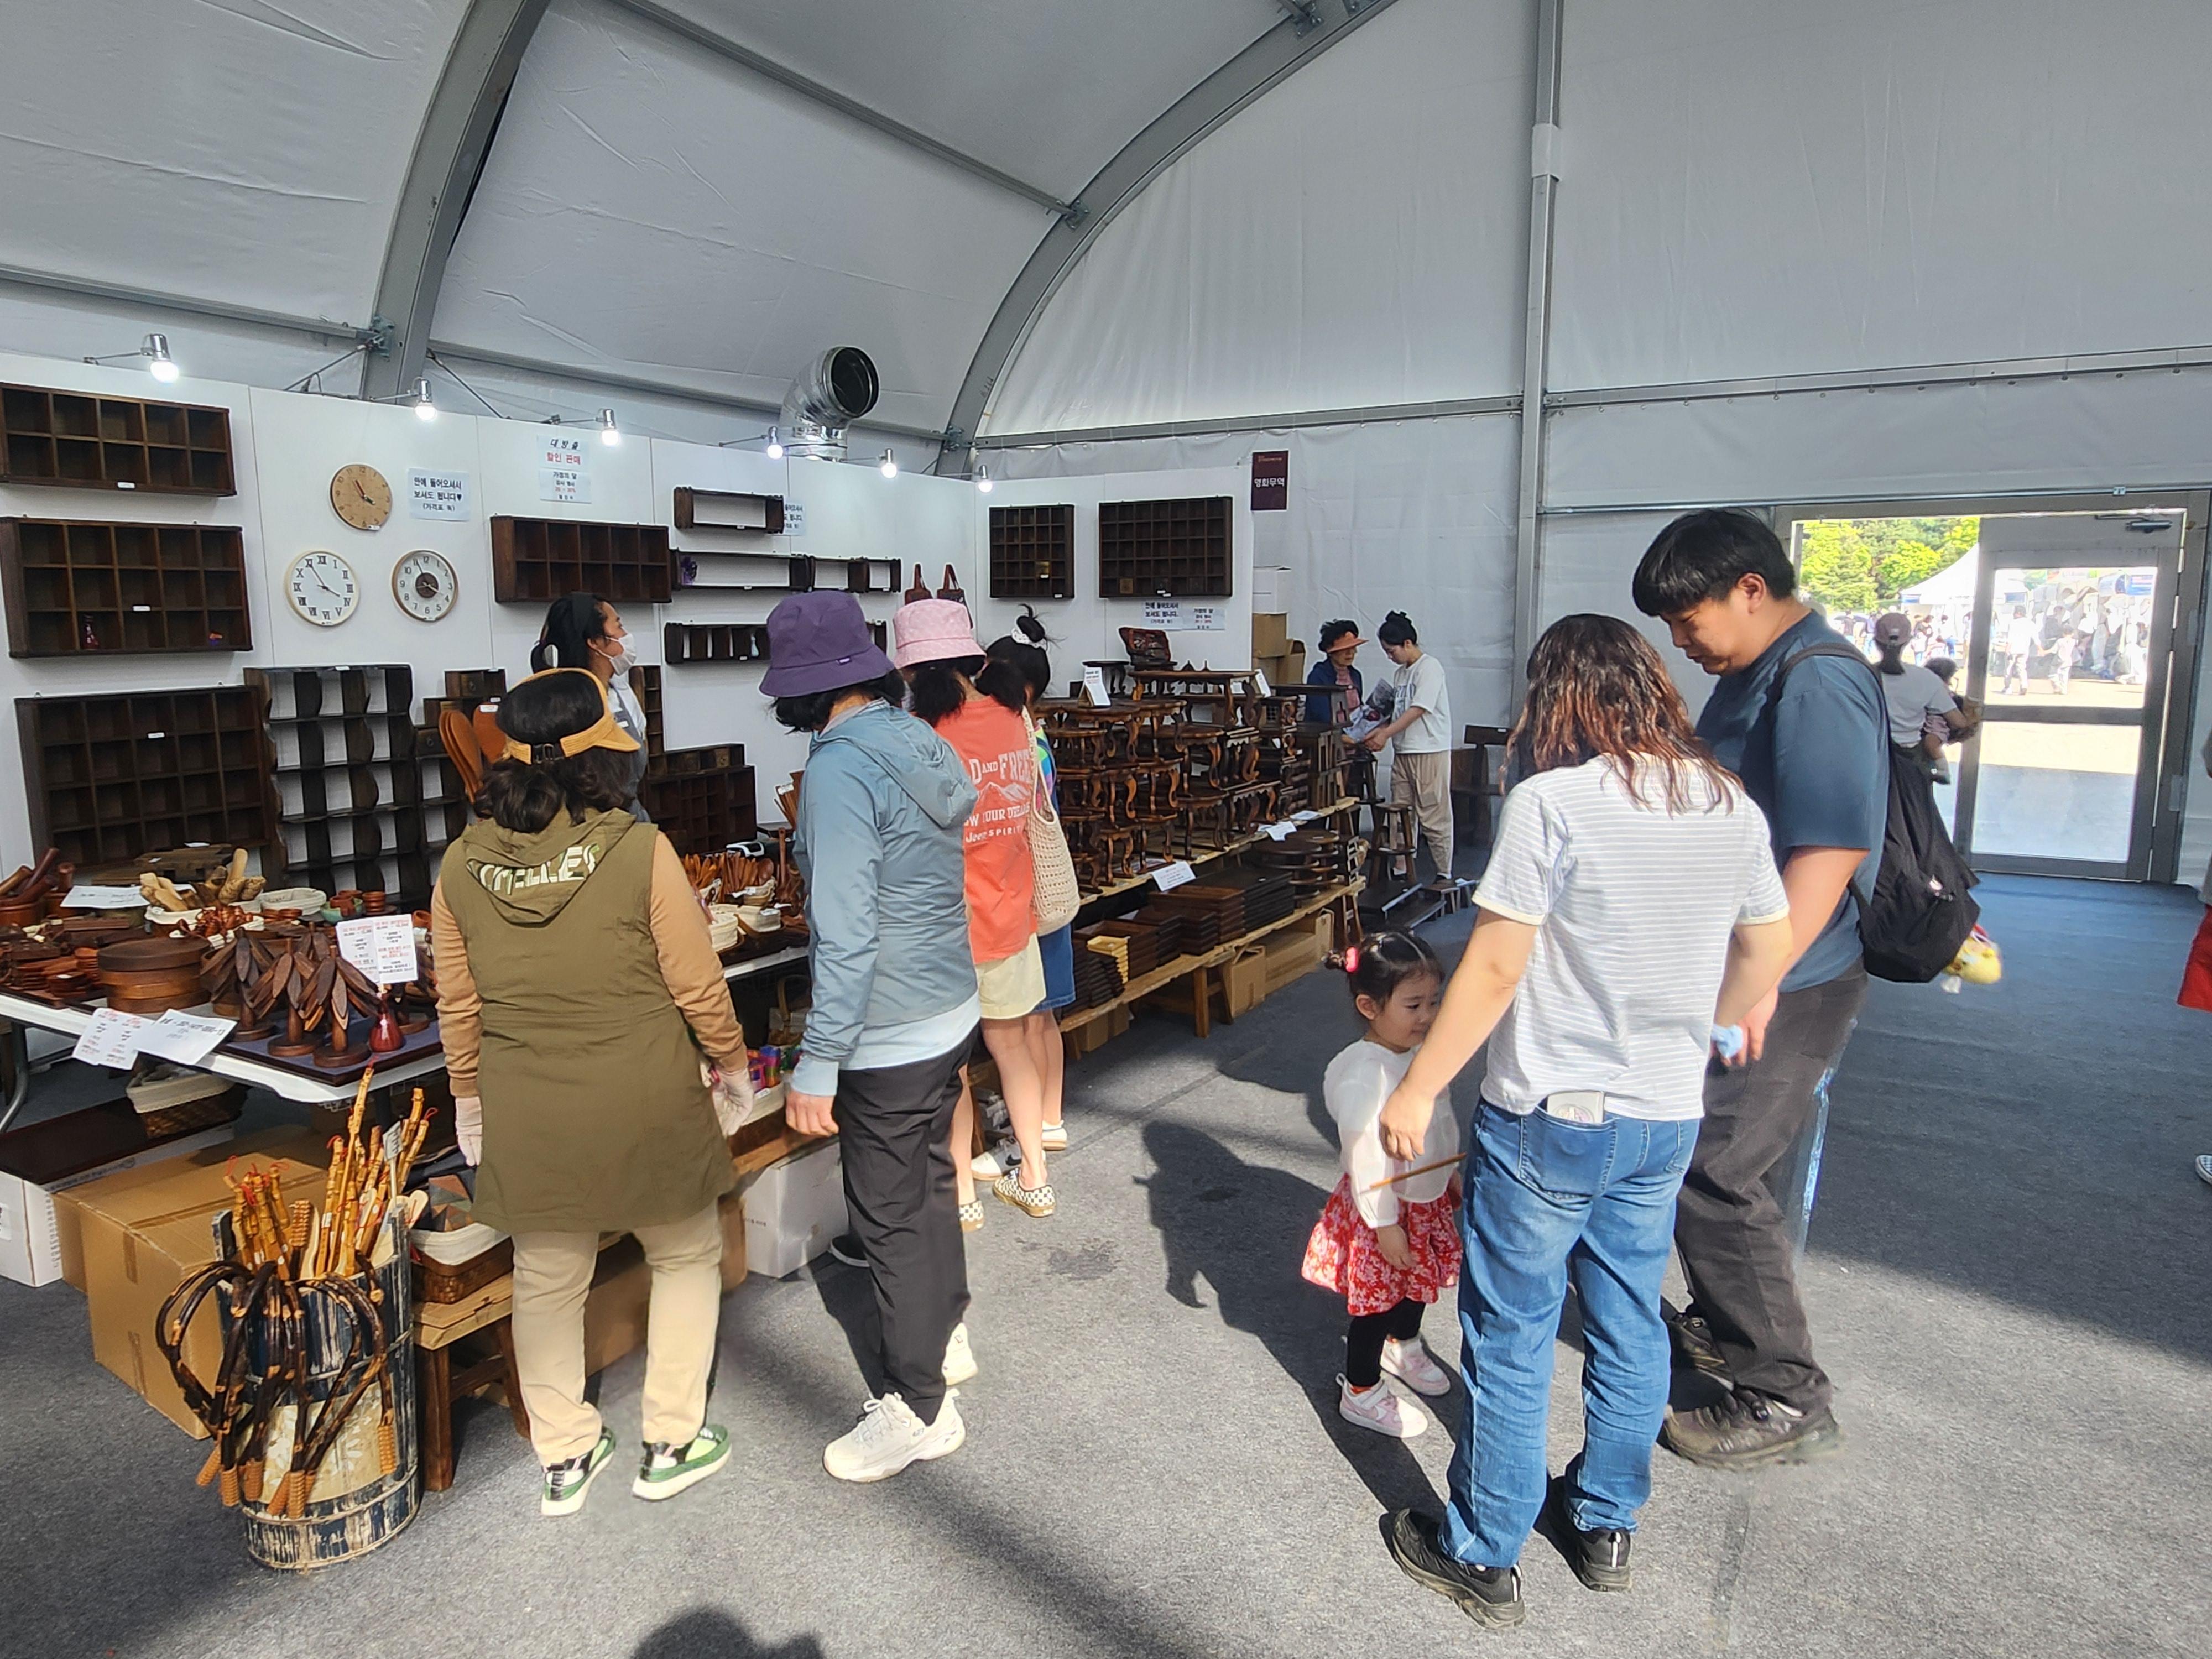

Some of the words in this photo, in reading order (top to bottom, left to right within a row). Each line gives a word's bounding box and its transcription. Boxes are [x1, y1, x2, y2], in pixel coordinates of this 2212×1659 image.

[546, 452, 562, 463] 할인
[566, 454, 581, 465] 판매
[436, 559, 440, 567] 1
[404, 566, 412, 575] 10
[399, 580, 405, 588] 9
[413, 602, 418, 610] 7
[424, 606, 430, 614] 6
[436, 603, 442, 612] 5
[982, 761, 999, 774] AND
